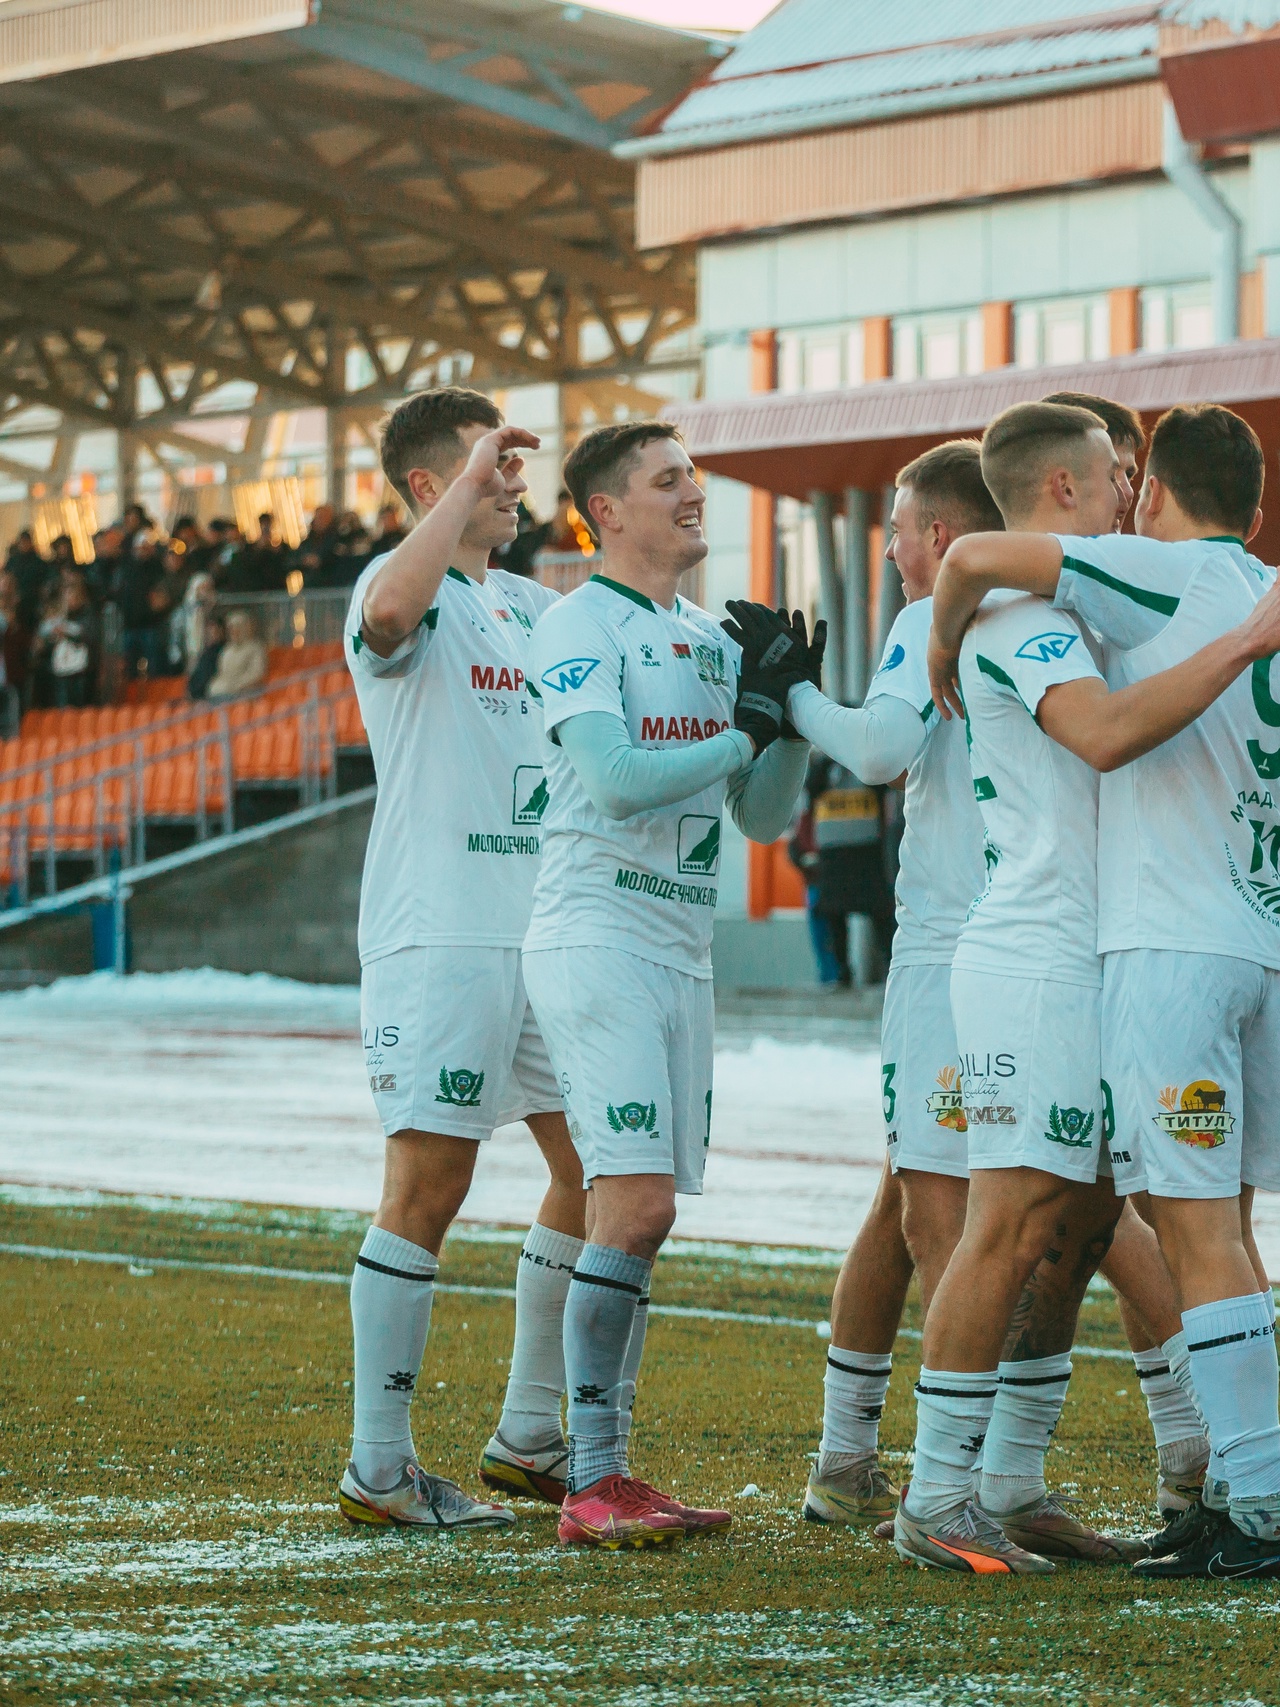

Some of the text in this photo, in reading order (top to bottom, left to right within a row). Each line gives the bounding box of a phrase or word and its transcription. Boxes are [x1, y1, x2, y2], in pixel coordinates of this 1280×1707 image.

[471, 664, 528, 692] МАР
[882, 1062, 897, 1124] 3
[1164, 1115, 1226, 1128] ТИТУЛ
